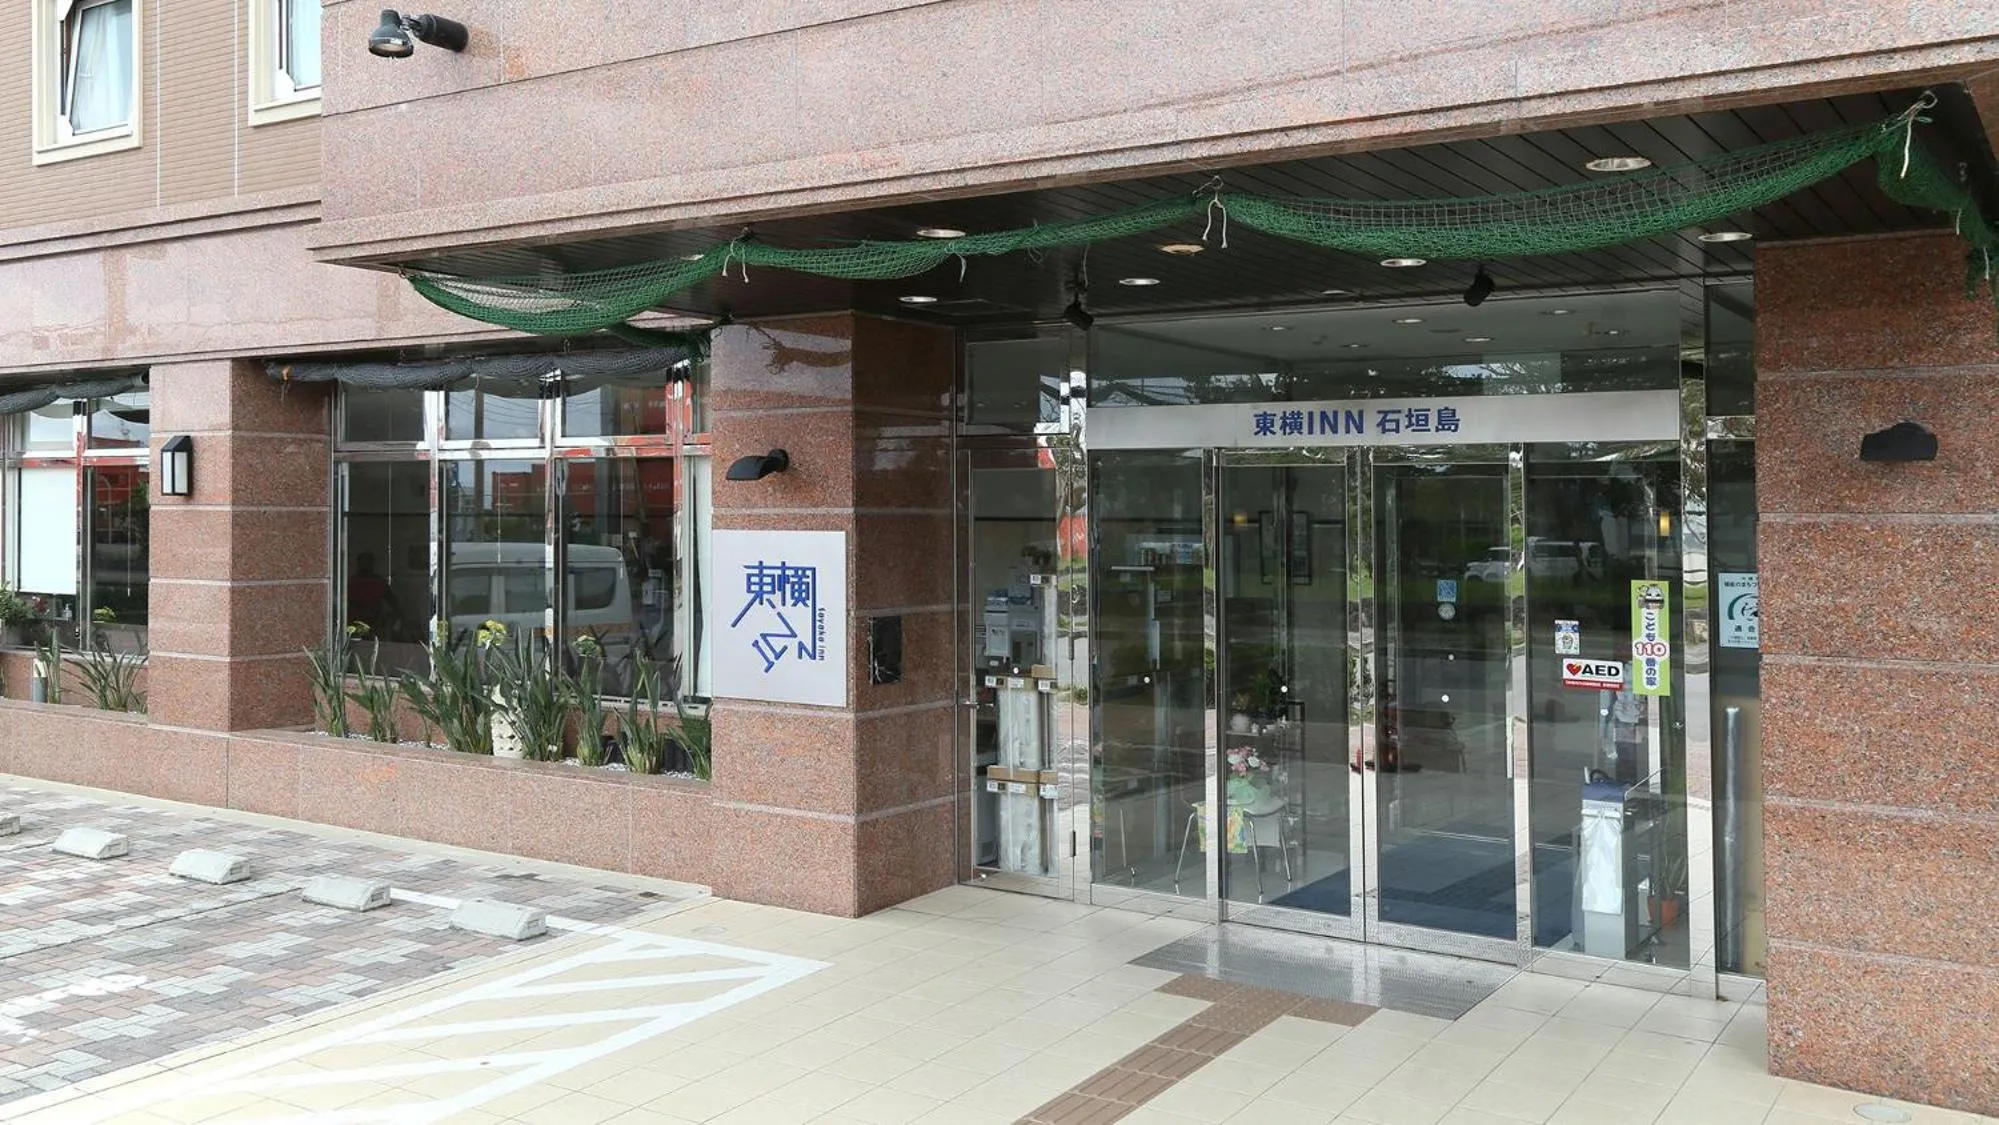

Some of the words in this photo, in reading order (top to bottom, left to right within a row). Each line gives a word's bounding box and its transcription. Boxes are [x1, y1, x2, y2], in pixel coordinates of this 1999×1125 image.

[1253, 410, 1365, 436] 東横INN
[1376, 406, 1461, 433] 石垣島
[1582, 663, 1620, 677] AED
